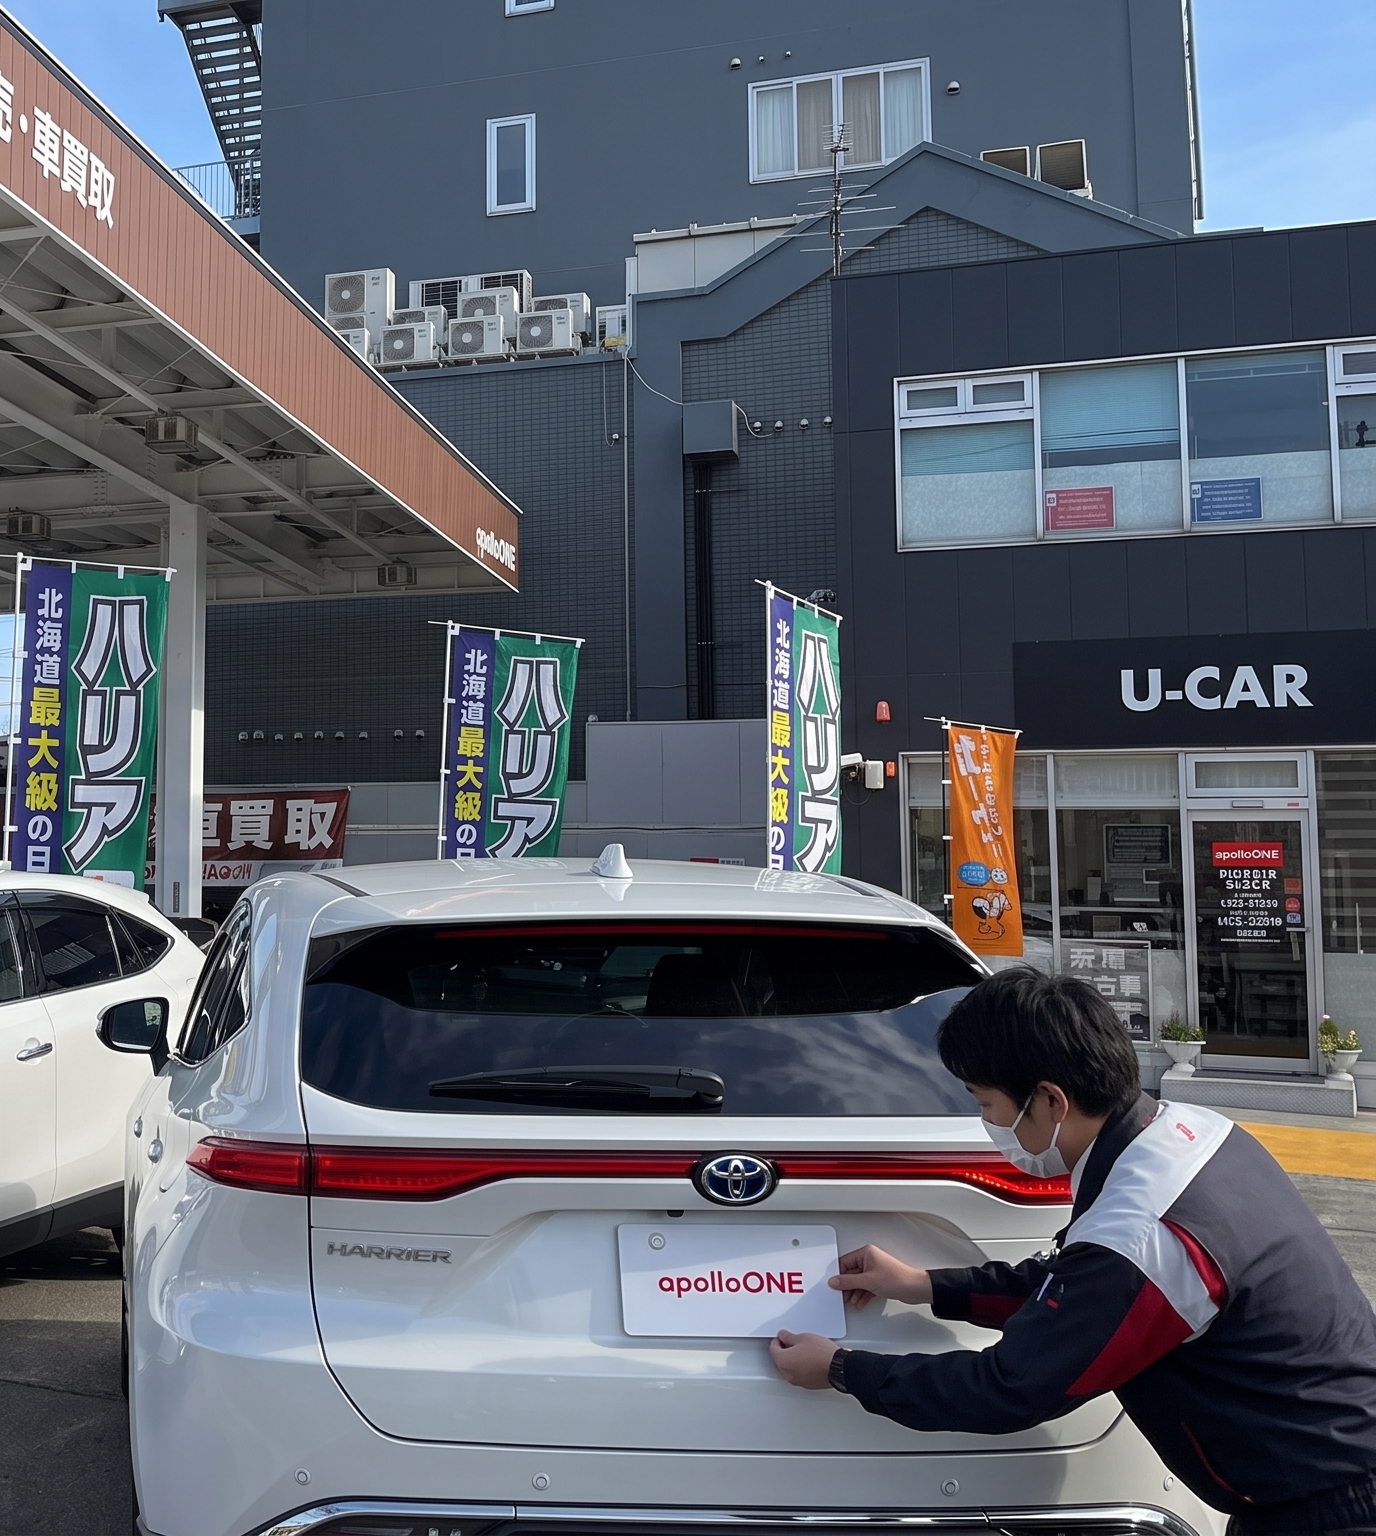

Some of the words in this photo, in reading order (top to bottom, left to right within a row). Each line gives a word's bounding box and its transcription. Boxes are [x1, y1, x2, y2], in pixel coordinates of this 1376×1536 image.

[1120, 664, 1314, 712] U-CAR
[25, 587, 64, 873] 北海道最大級の日
[61, 594, 157, 874] ハリア
[1215, 849, 1280, 861] apolloONE
[326, 1242, 453, 1264] HARRIER
[658, 1270, 805, 1299] apolloONE
